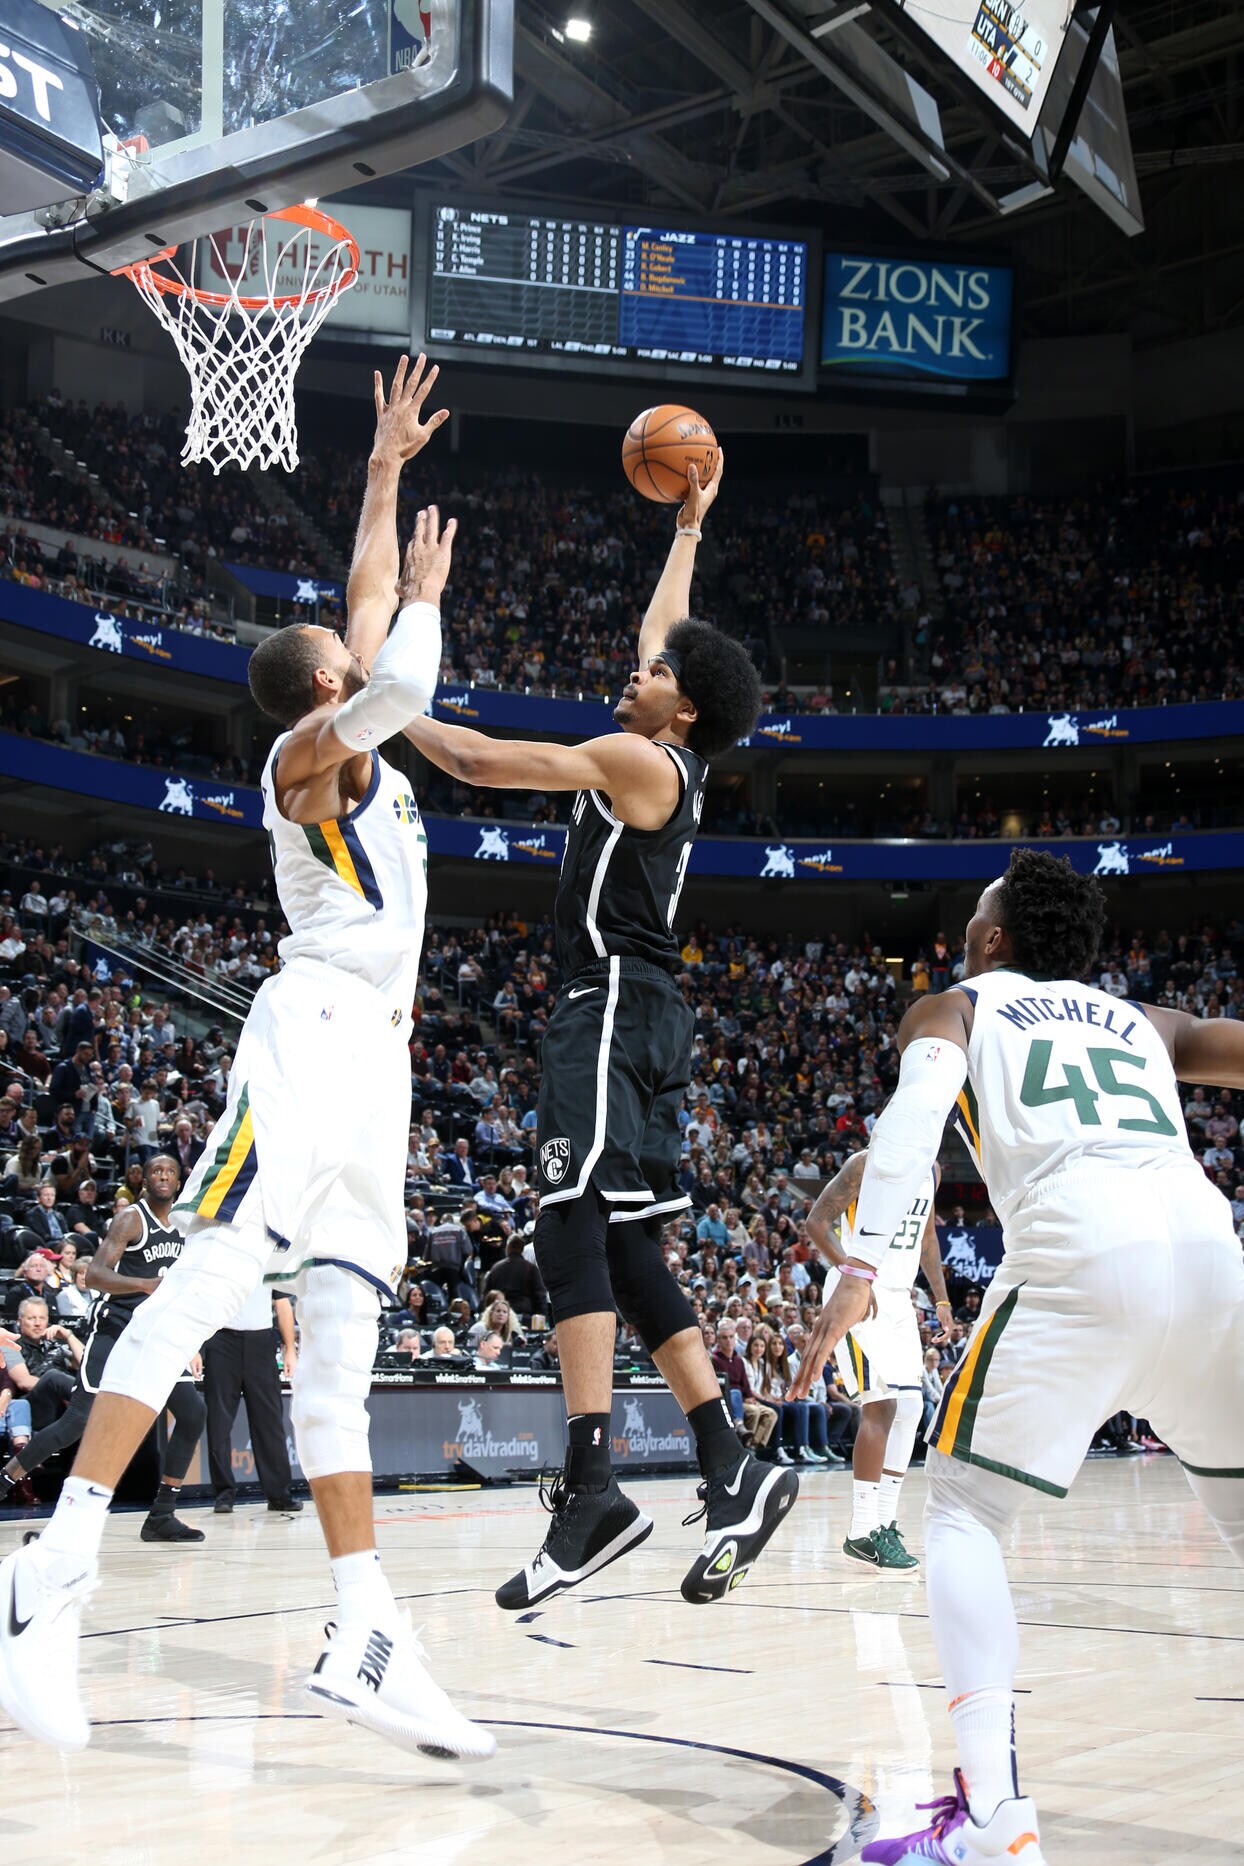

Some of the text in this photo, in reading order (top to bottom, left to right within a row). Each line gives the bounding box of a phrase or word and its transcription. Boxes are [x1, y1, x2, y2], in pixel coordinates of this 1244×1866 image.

[977, 14, 997, 48] UTA
[971, 40, 988, 66] 11:06
[991, 60, 1001, 78] 10
[1034, 40, 1042, 56] 0
[1026, 67, 1033, 84] 2
[470, 212, 508, 225] NETS
[660, 232, 696, 244] JAZZ
[277, 241, 408, 279] HEATH
[354, 282, 369, 294] OF
[374, 284, 408, 298] UTAH
[839, 258, 990, 310] ZIONS
[836, 307, 987, 360] BANK
[996, 997, 1137, 1046] MITCHELL
[1020, 1039, 1178, 1137] 45
[542, 1140, 569, 1165] NETS
[889, 1220, 921, 1250] 23
[143, 1241, 183, 1263] BROOKL
[612, 1431, 690, 1457] trydaytrading
[357, 1629, 394, 1694] NIKE
